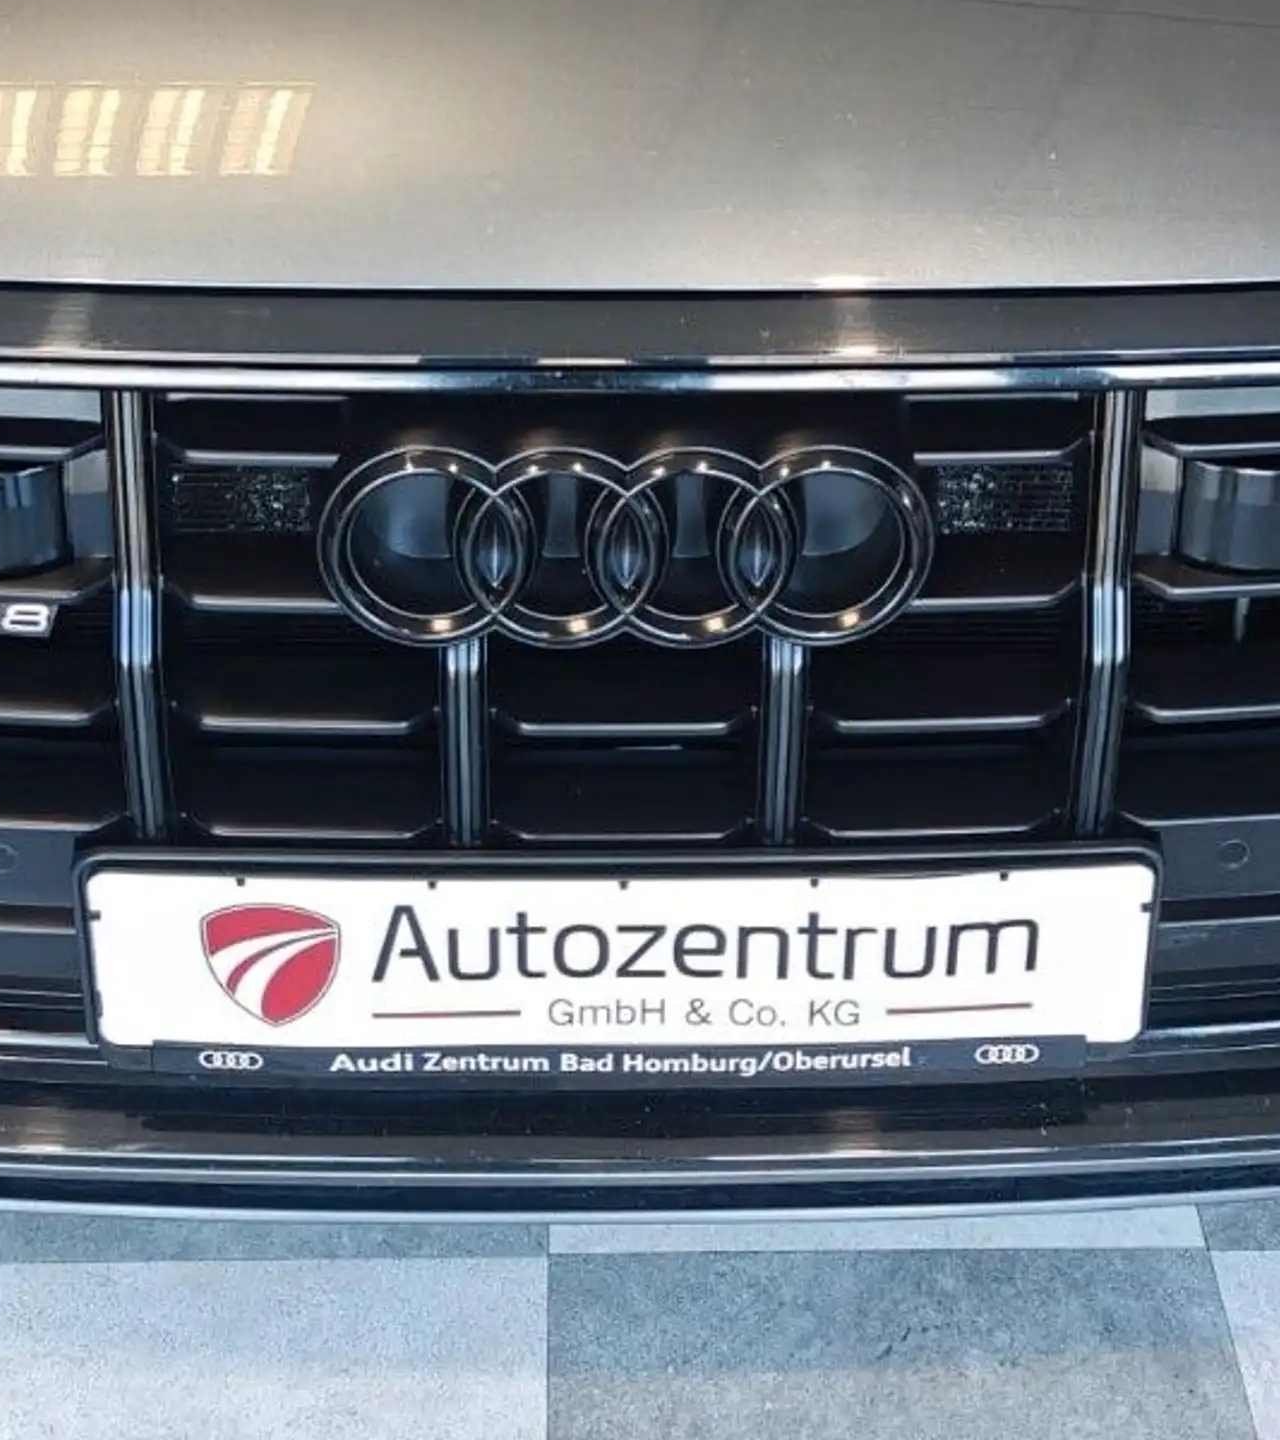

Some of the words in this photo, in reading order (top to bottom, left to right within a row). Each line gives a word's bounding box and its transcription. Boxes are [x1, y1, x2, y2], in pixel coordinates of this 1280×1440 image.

[371, 905, 1040, 983] Autozentrum
[547, 998, 666, 1026] GmbH
[684, 998, 713, 1026] &
[728, 998, 786, 1027] Co.
[808, 999, 861, 1026] KG
[329, 1053, 414, 1073] Audi
[422, 1052, 550, 1073] Zentrum
[560, 1052, 613, 1073] Bad
[622, 1046, 911, 1079] Homburg/Oberursel
